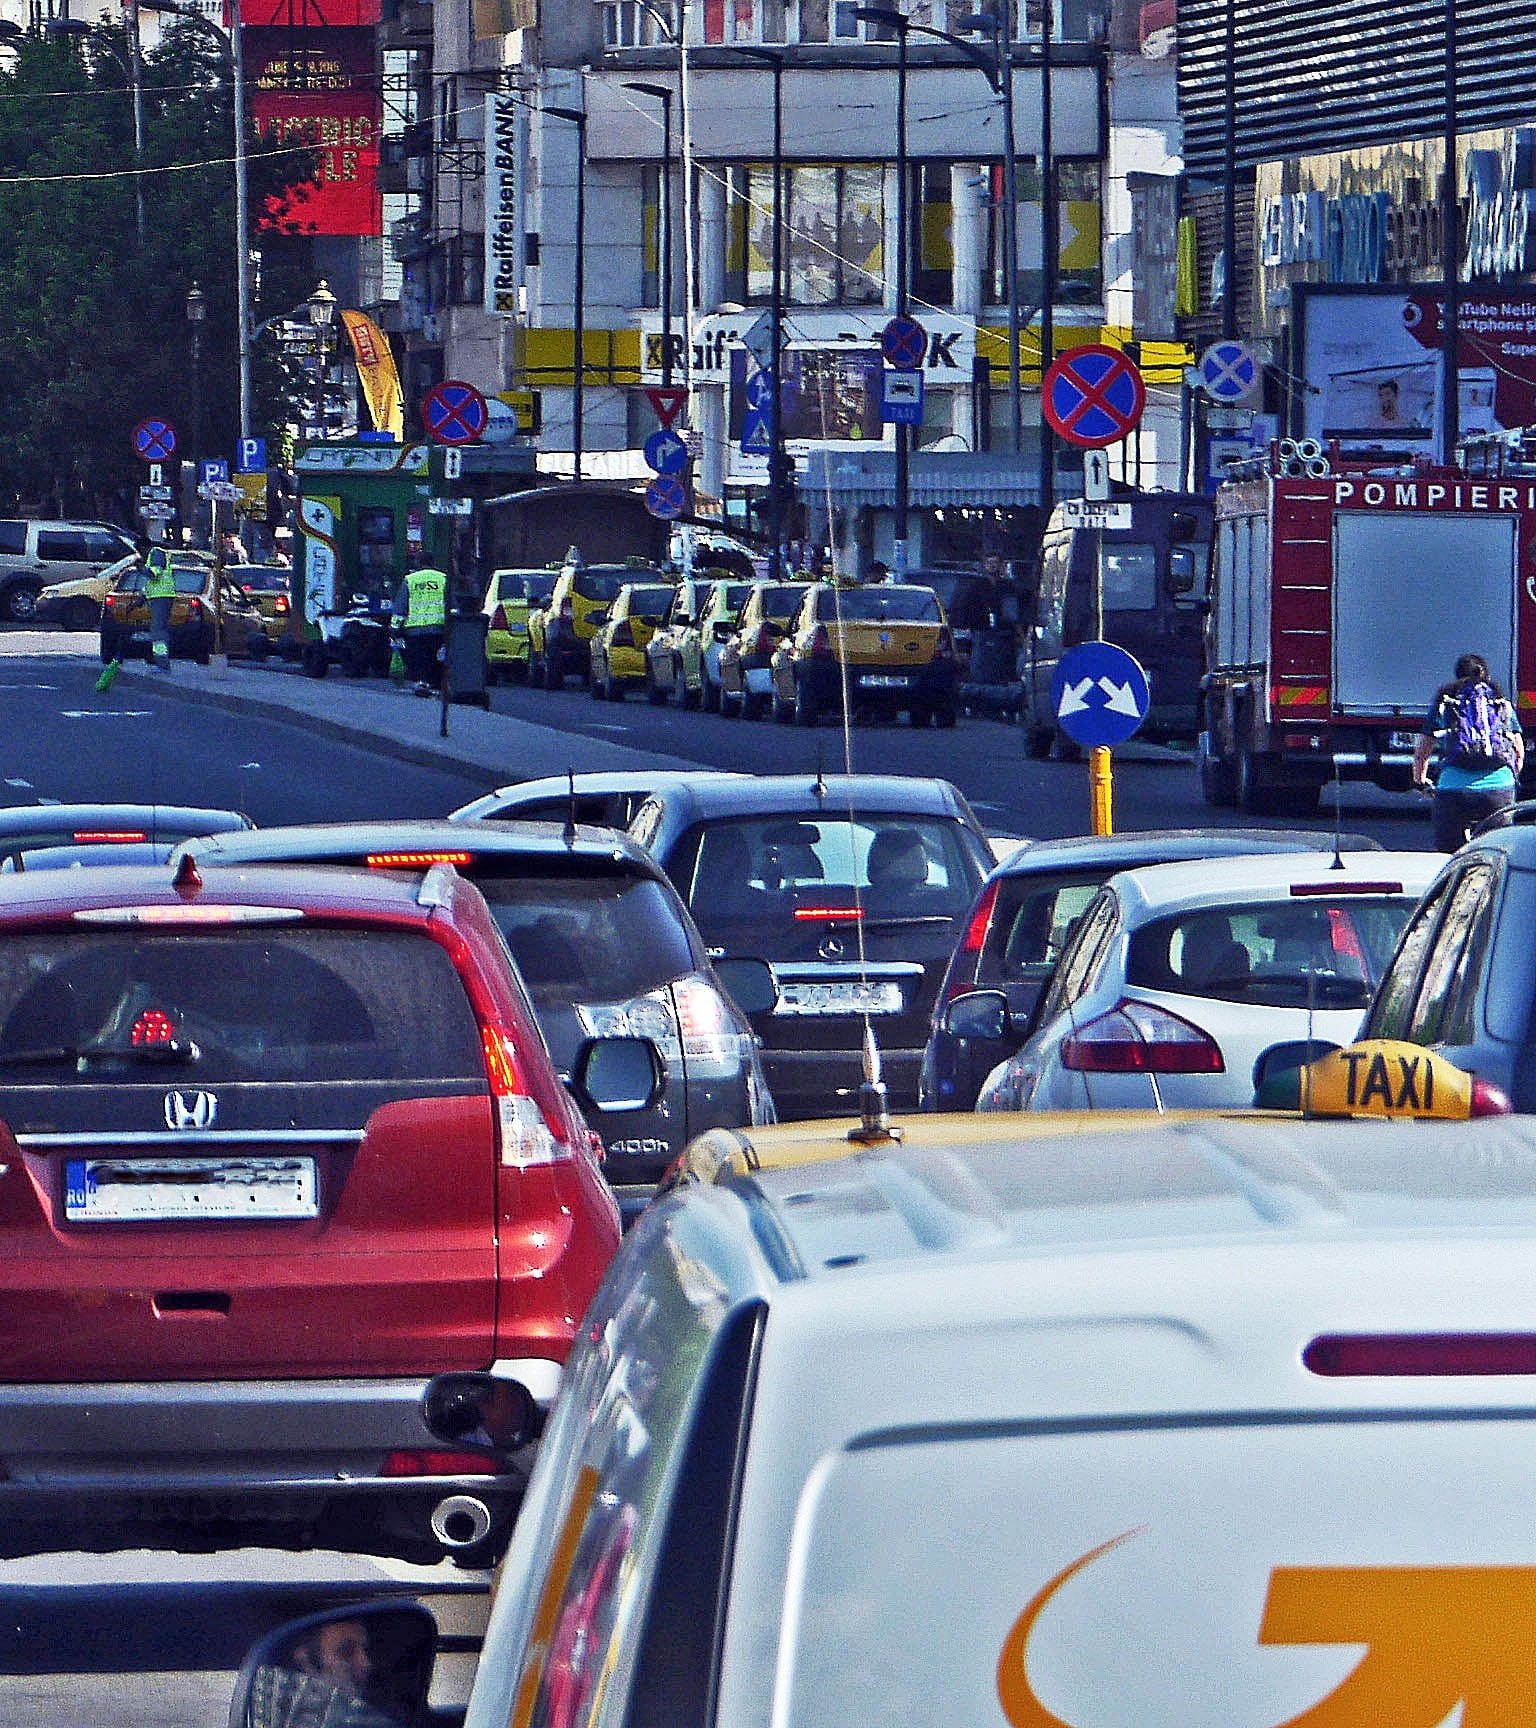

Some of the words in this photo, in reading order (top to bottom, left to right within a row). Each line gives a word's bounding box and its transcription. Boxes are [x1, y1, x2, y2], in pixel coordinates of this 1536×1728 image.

[1334, 481, 1535, 510] POMPIERI
[1340, 1052, 1434, 1110] TAXI
[609, 1138, 670, 1153] 400h
